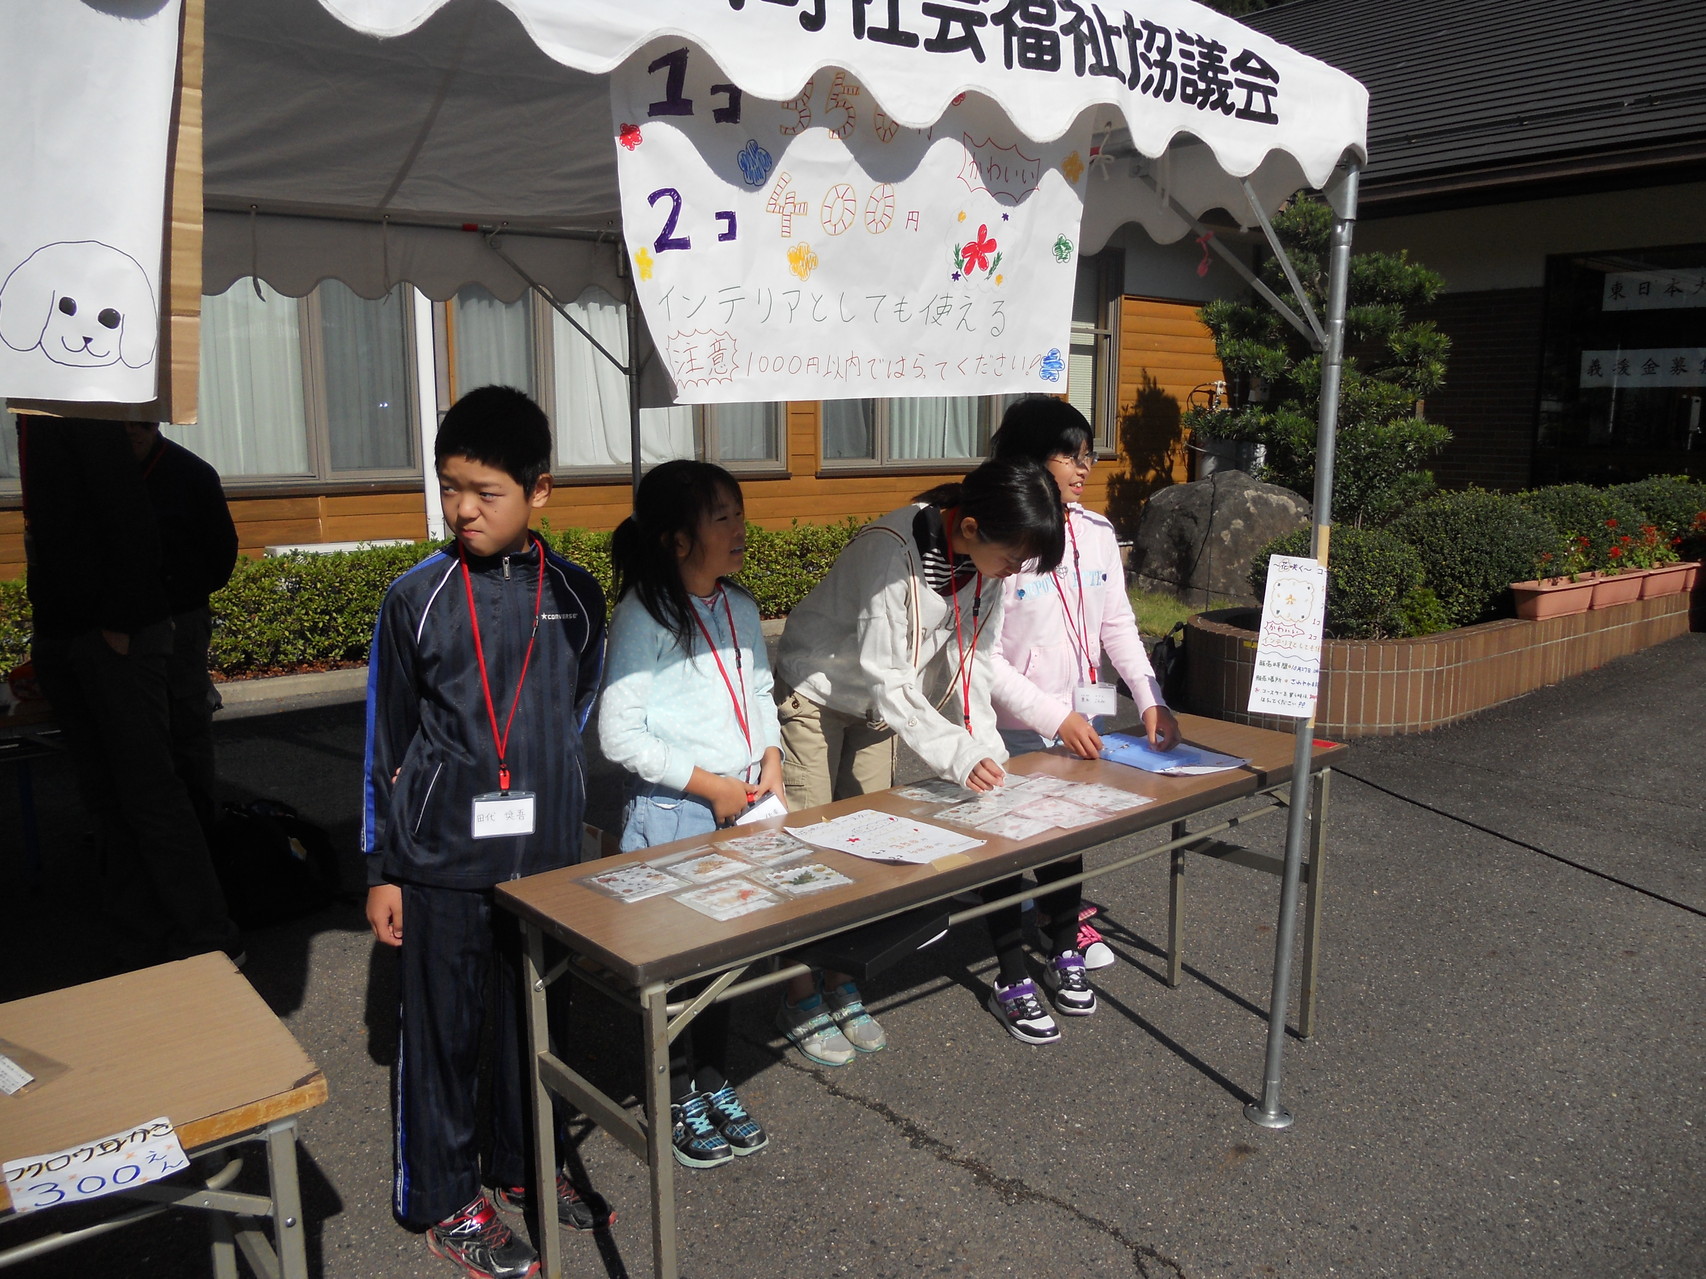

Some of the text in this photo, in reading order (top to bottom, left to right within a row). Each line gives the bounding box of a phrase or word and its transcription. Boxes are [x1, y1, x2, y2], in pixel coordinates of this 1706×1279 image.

[780, 72, 933, 141] 350
[968, 152, 1035, 184] かわいい
[658, 285, 1006, 337] インテリアとしても使える
